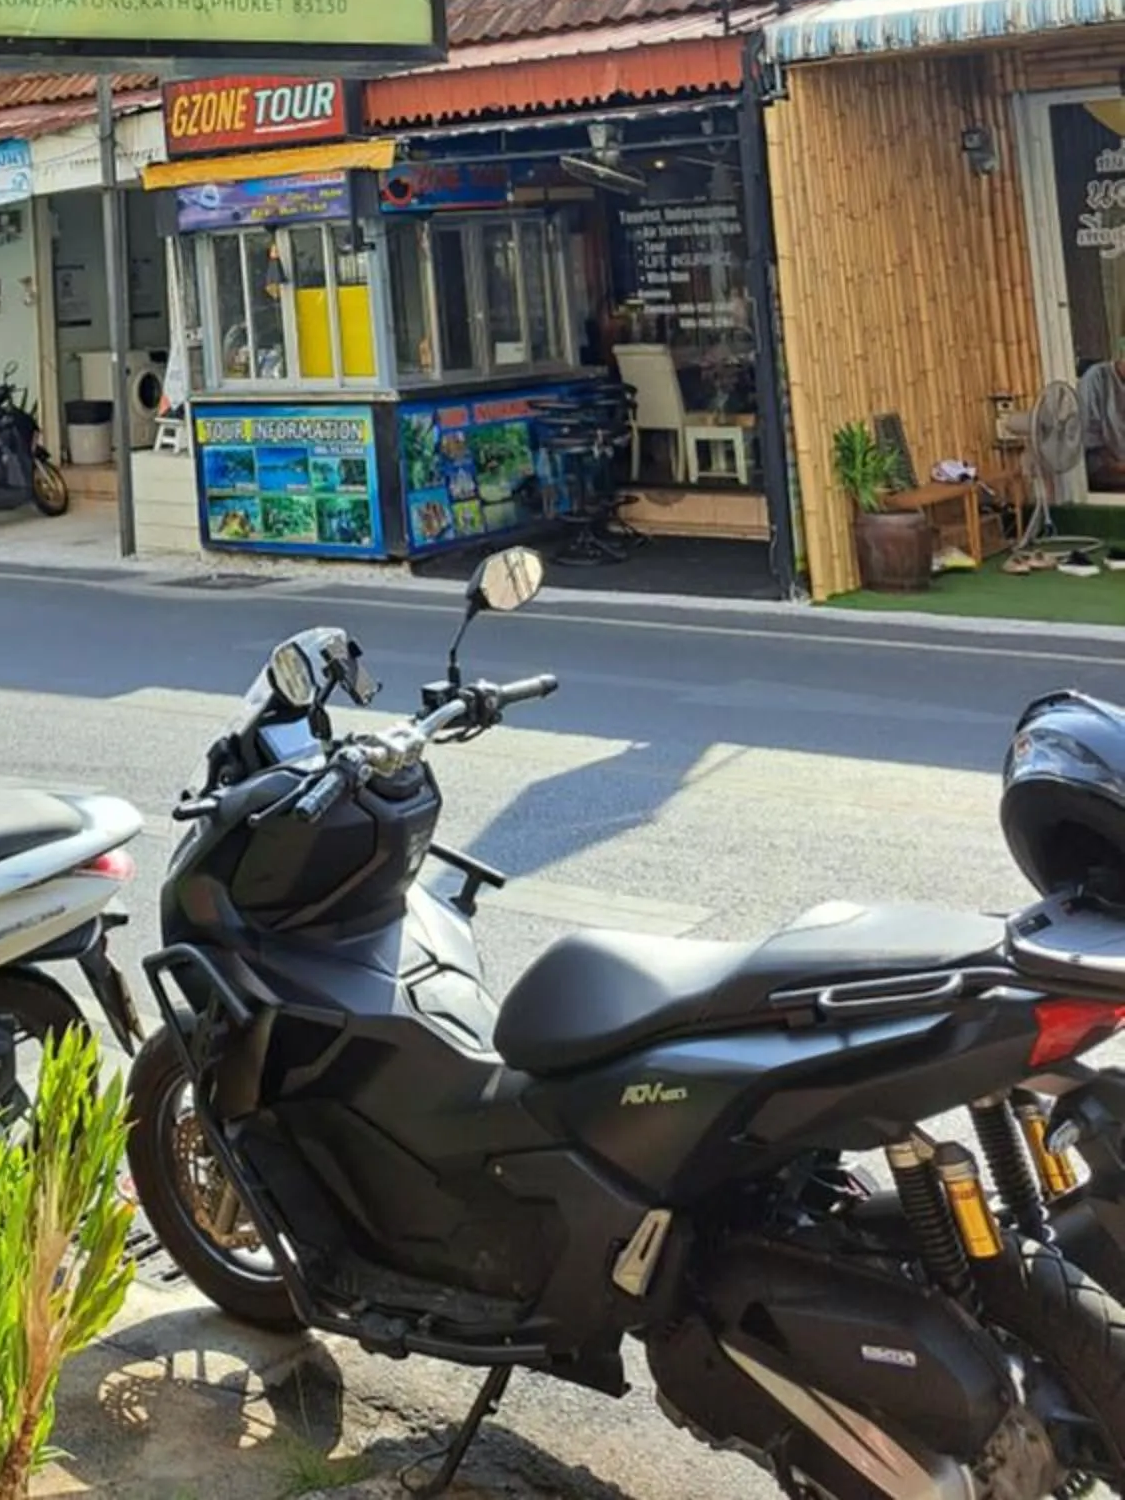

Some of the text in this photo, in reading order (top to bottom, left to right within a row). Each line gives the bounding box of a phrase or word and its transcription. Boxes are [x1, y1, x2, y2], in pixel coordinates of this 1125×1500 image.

[171, 81, 336, 137] GZONE TOUR
[206, 419, 364, 441] TOUR INFORMATION
